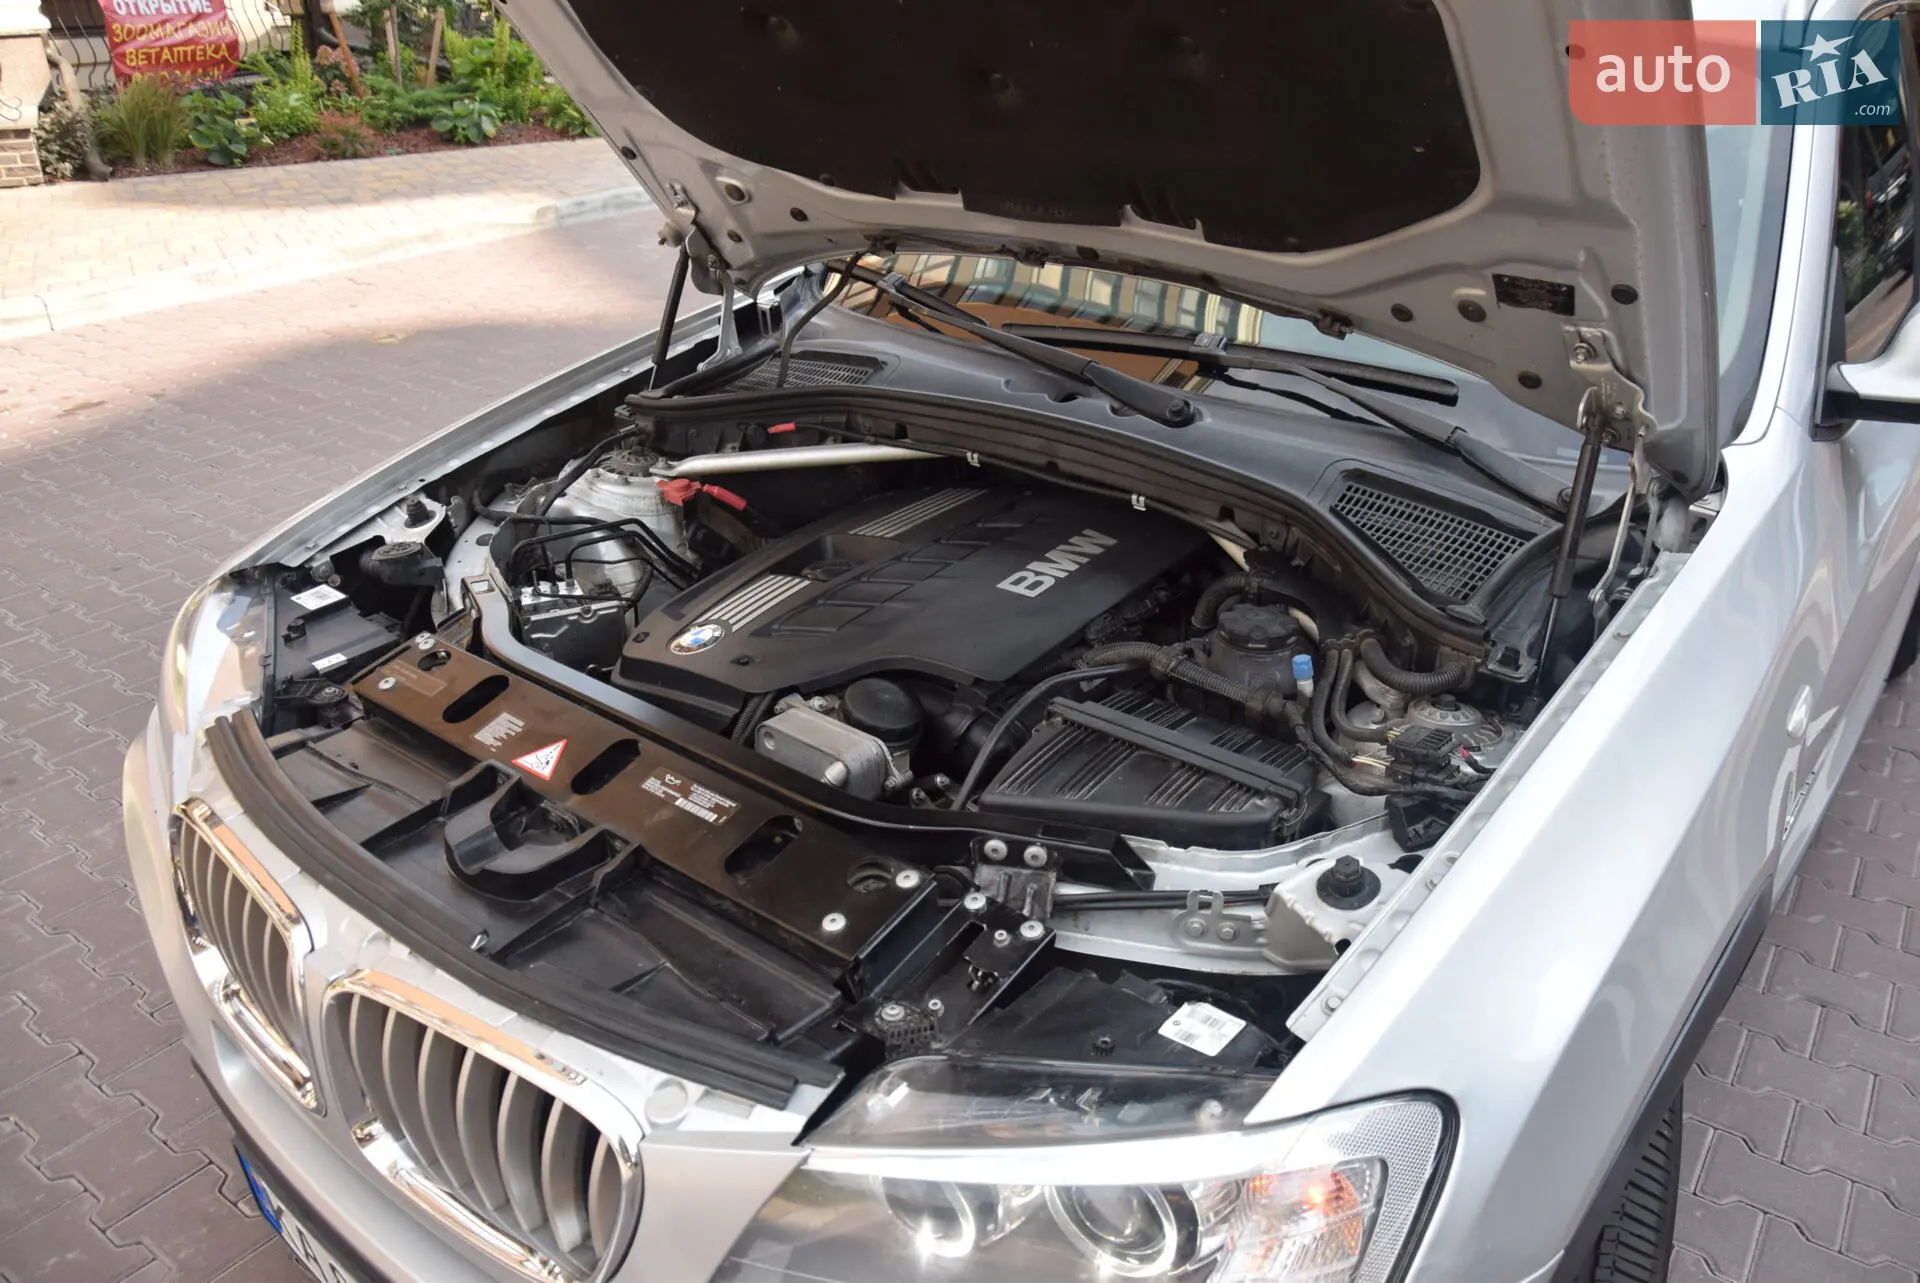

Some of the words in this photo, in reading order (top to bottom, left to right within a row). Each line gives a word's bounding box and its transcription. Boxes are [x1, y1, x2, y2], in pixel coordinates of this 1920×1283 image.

[114, 0, 211, 15] ОТКРЫТИЕ
[111, 20, 233, 43] ЗООМАГАЗИН
[126, 43, 228, 66] ВЕТАПТЕКА
[995, 528, 1119, 598] BMW
